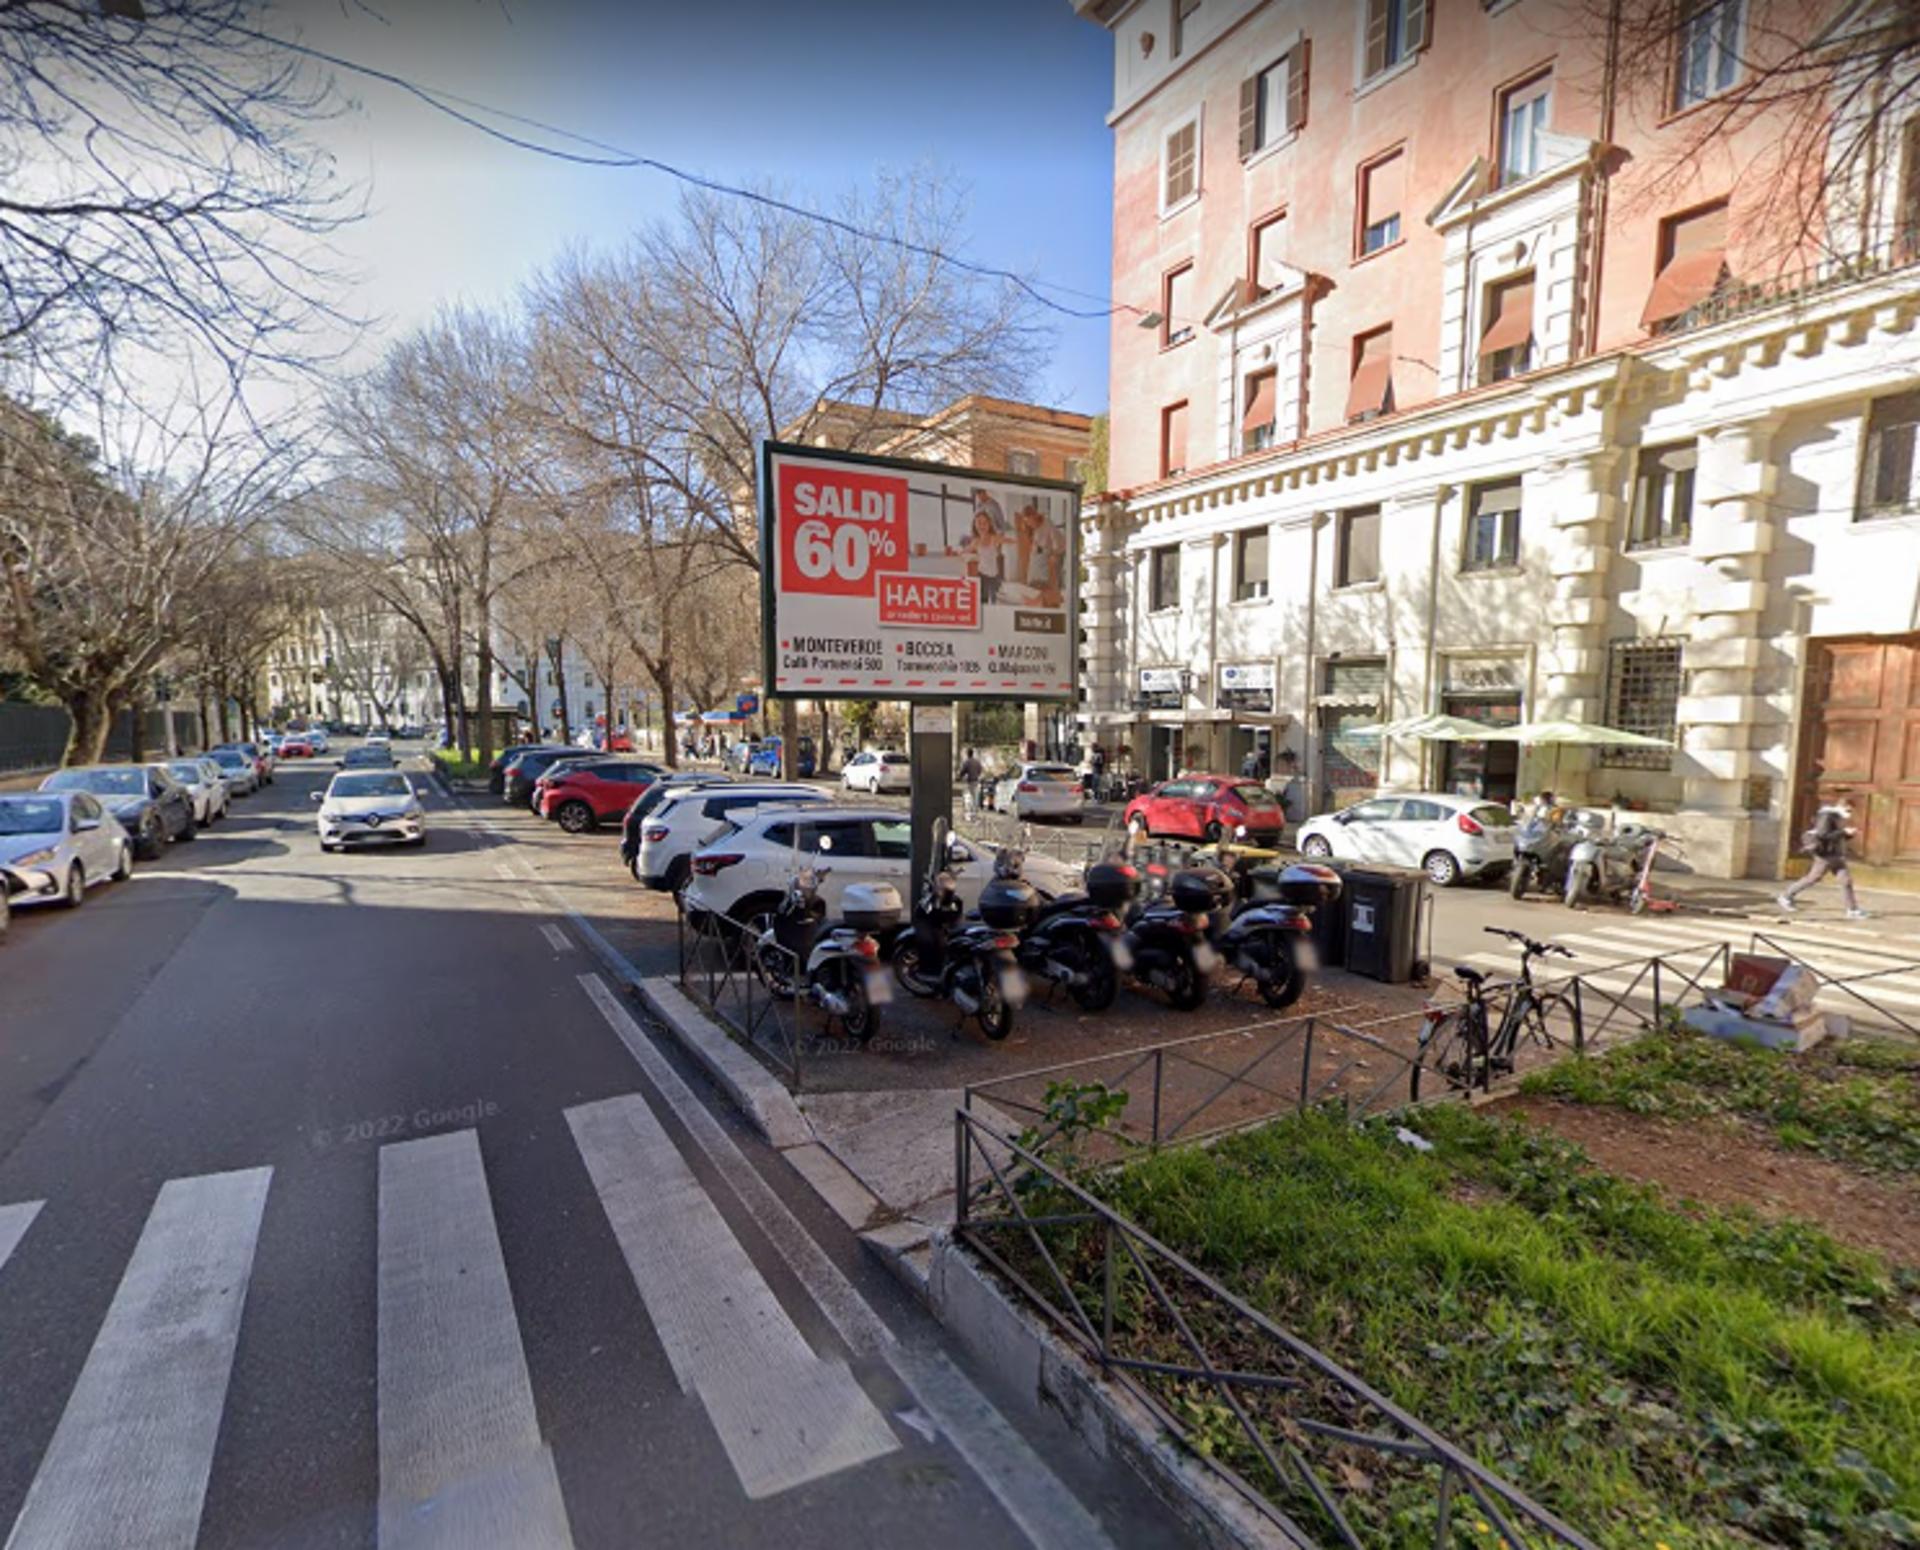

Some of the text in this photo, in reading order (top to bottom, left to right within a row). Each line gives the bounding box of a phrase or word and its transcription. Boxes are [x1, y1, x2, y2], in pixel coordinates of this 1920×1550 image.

[794, 482, 895, 523] SALDI
[794, 520, 896, 580] 60%
[793, 637, 883, 655] MONTEVERDE
